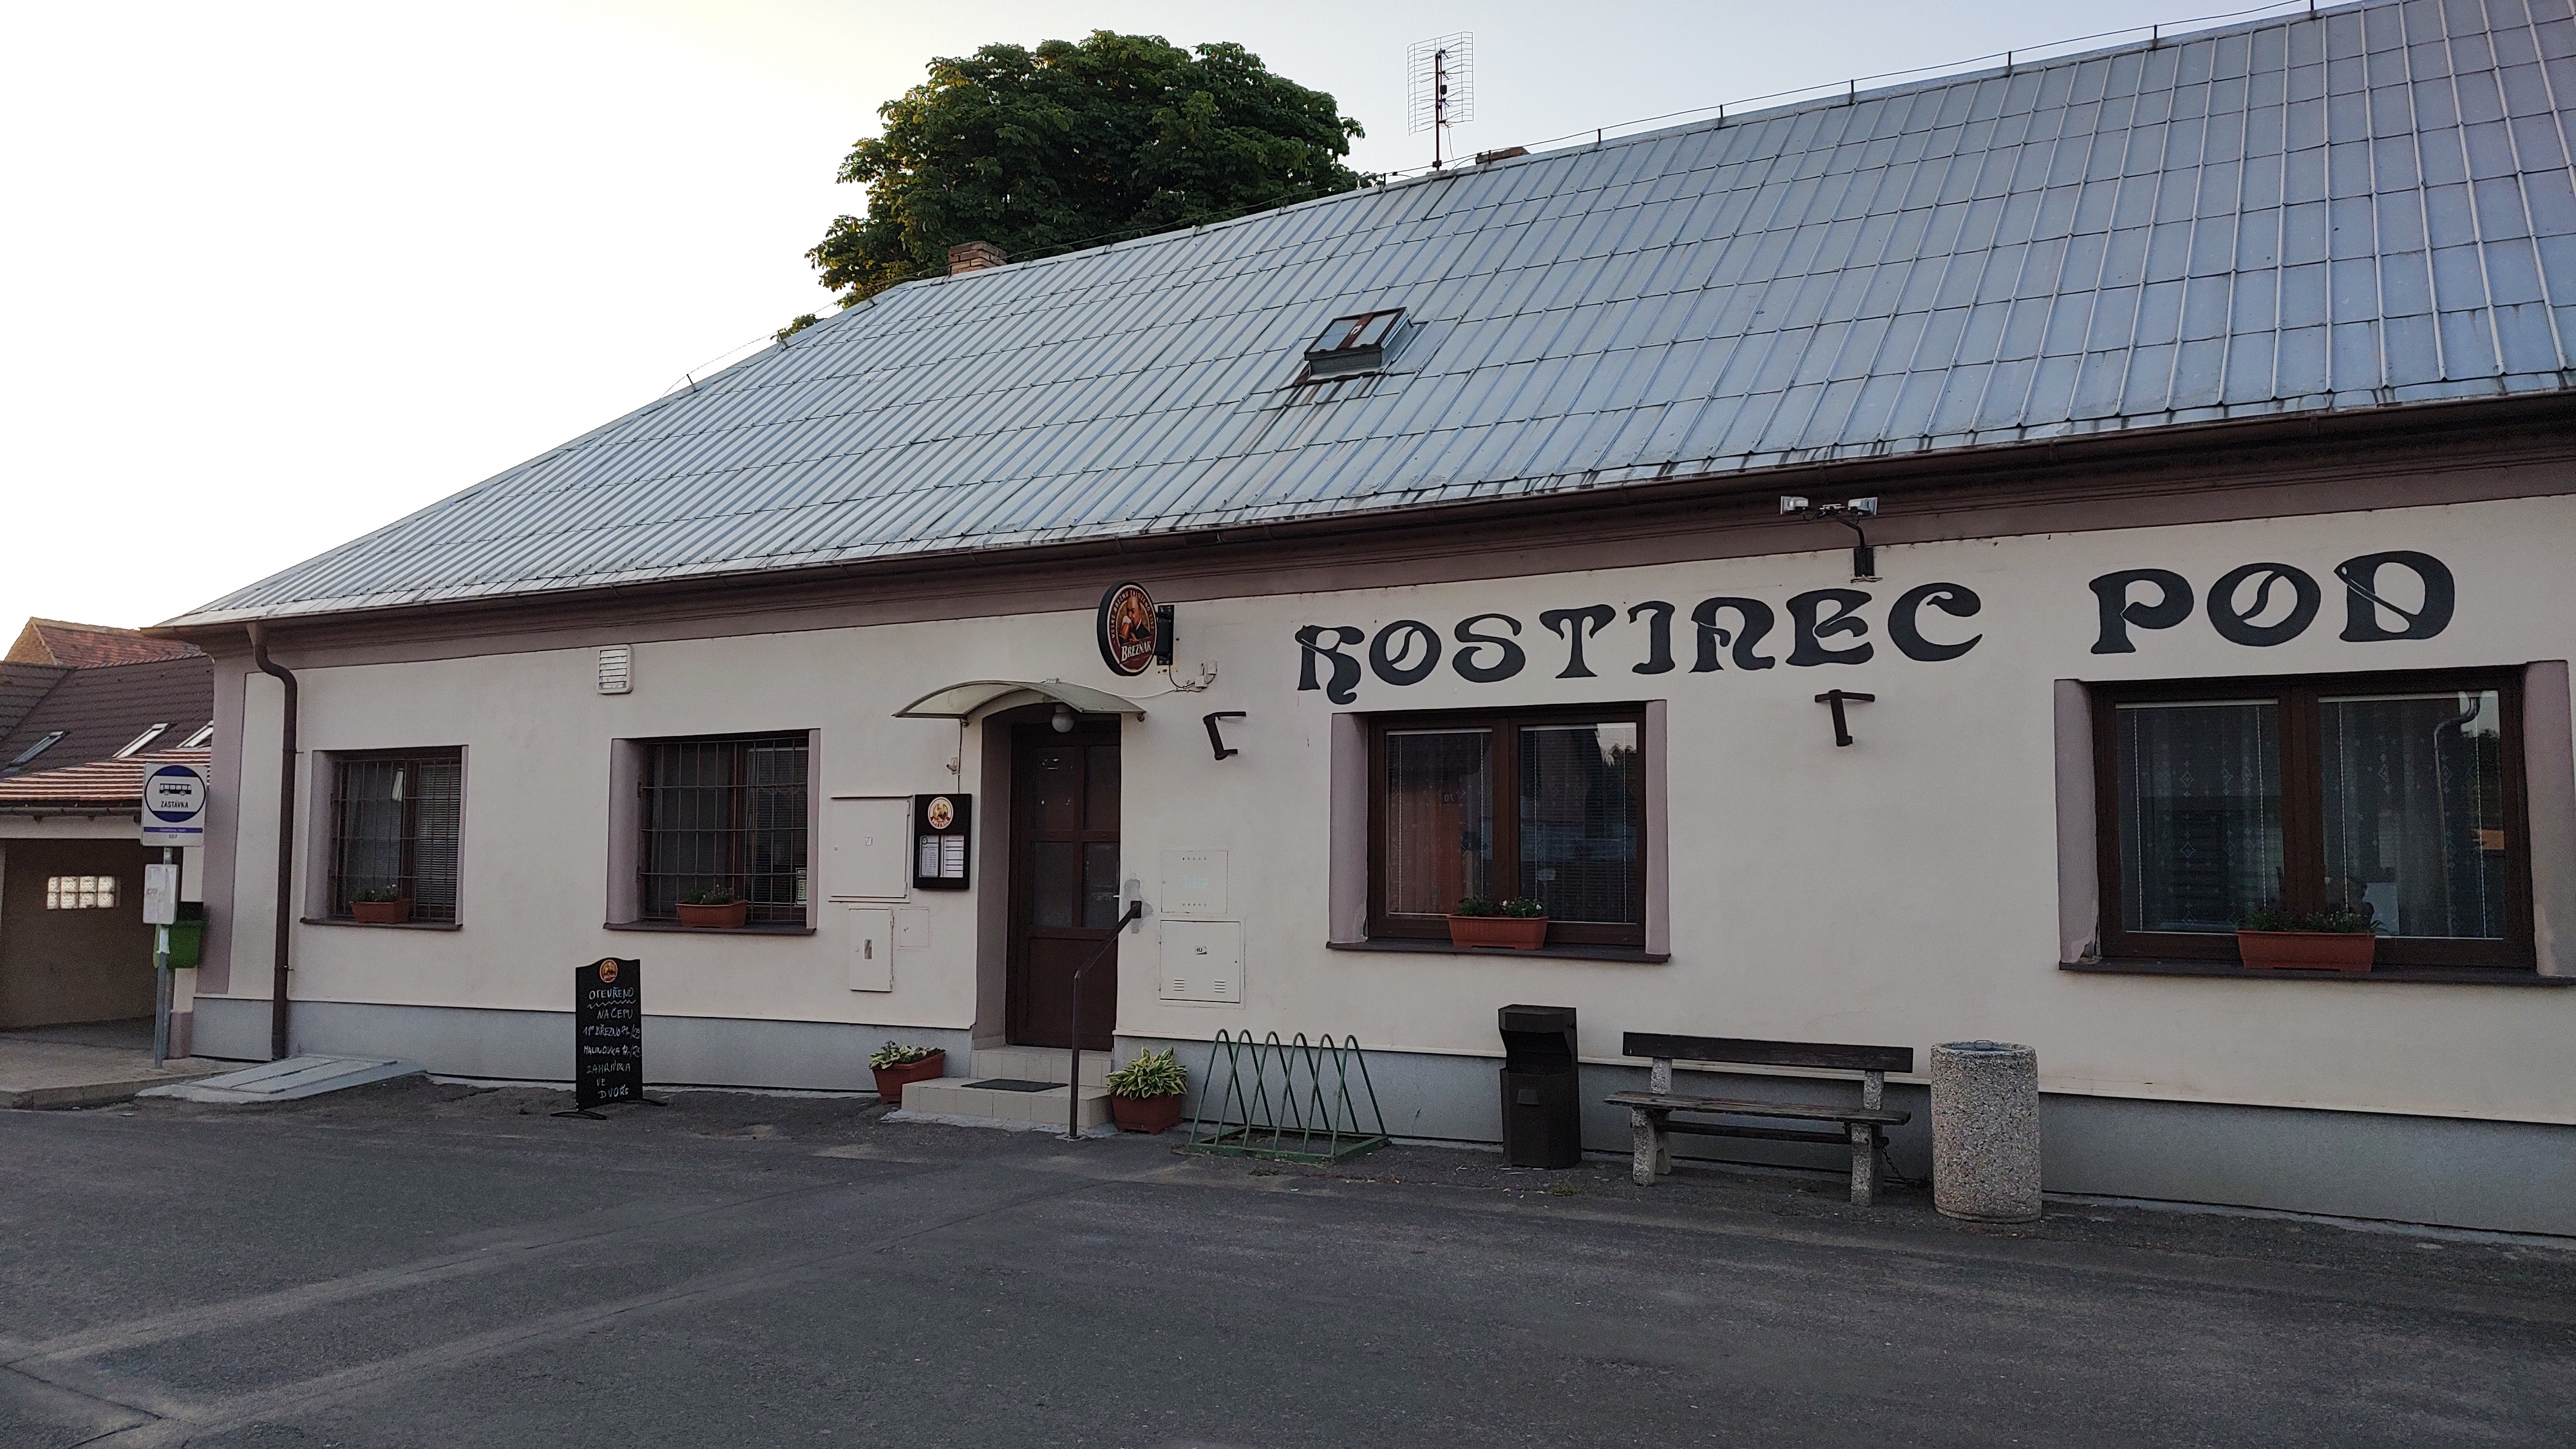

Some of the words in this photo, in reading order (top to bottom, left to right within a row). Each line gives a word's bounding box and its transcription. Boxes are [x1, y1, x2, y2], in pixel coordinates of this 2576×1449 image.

[2088, 551, 2456, 655] POD
[161, 800, 189, 808] ZASTÁVKA
[589, 987, 634, 1000] OTEVŘENO
[597, 1009, 609, 1020] NA
[611, 1007, 633, 1019] ČEPU
[596, 1077, 606, 1086] VE
[597, 1084, 629, 1099] DVOŘE
